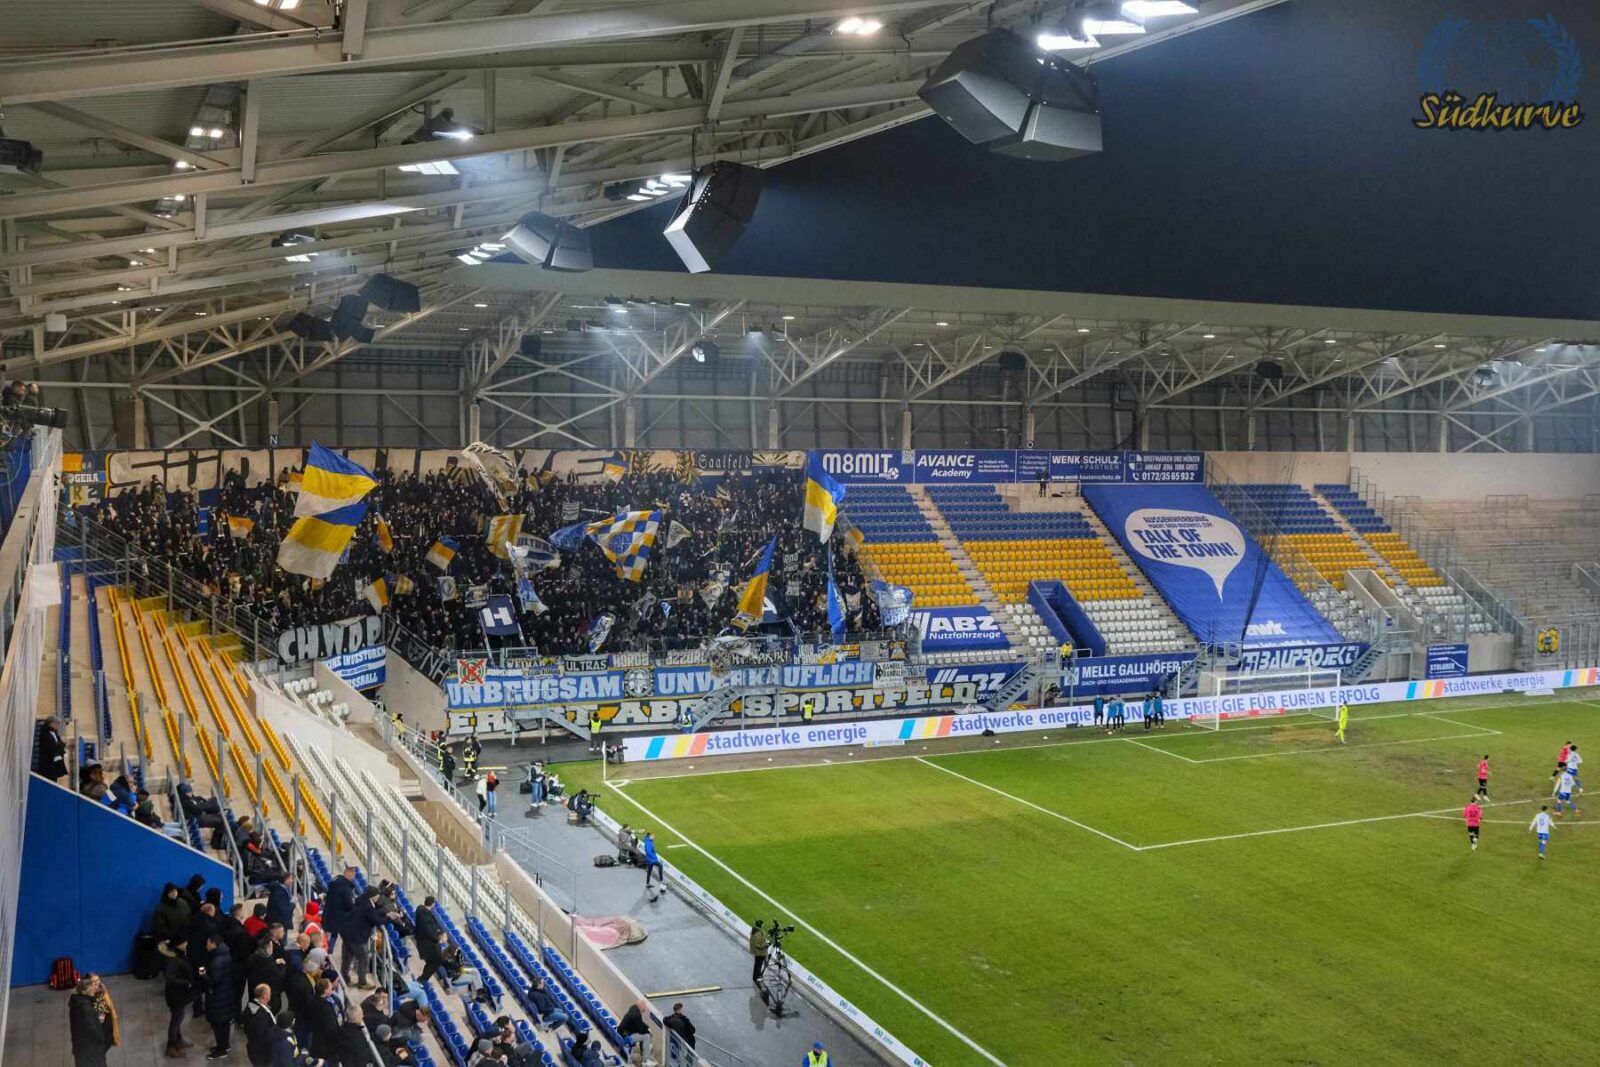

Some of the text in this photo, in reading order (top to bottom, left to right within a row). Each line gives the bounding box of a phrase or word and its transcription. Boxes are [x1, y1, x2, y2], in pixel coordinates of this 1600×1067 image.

[699, 453, 750, 470] Saalfeld
[917, 455, 975, 467] AVANCE
[1052, 455, 1080, 464] WENK
[931, 468, 972, 479] Academy
[1133, 528, 1202, 543] TALK OF
[1144, 542, 1239, 558] THE TOWN!
[482, 606, 513, 628] H
[930, 615, 999, 632] ABZ
[928, 631, 1001, 640] Nutzfahrzeuge
[566, 659, 608, 672] ULTRAS
[1082, 660, 1179, 678] MELLE GALLHÖFER
[447, 675, 620, 705] UNBEUGSAM
[1443, 674, 1545, 693] stadtwerke energie
[1184, 698, 1245, 716] ENERGIE
[1250, 693, 1276, 710] FÜR
[1282, 691, 1325, 708] EUREN
[1330, 687, 1380, 704] ERFOLG
[952, 707, 1091, 732] stadtwerke energie
[707, 724, 868, 750] stadtwerke energie
